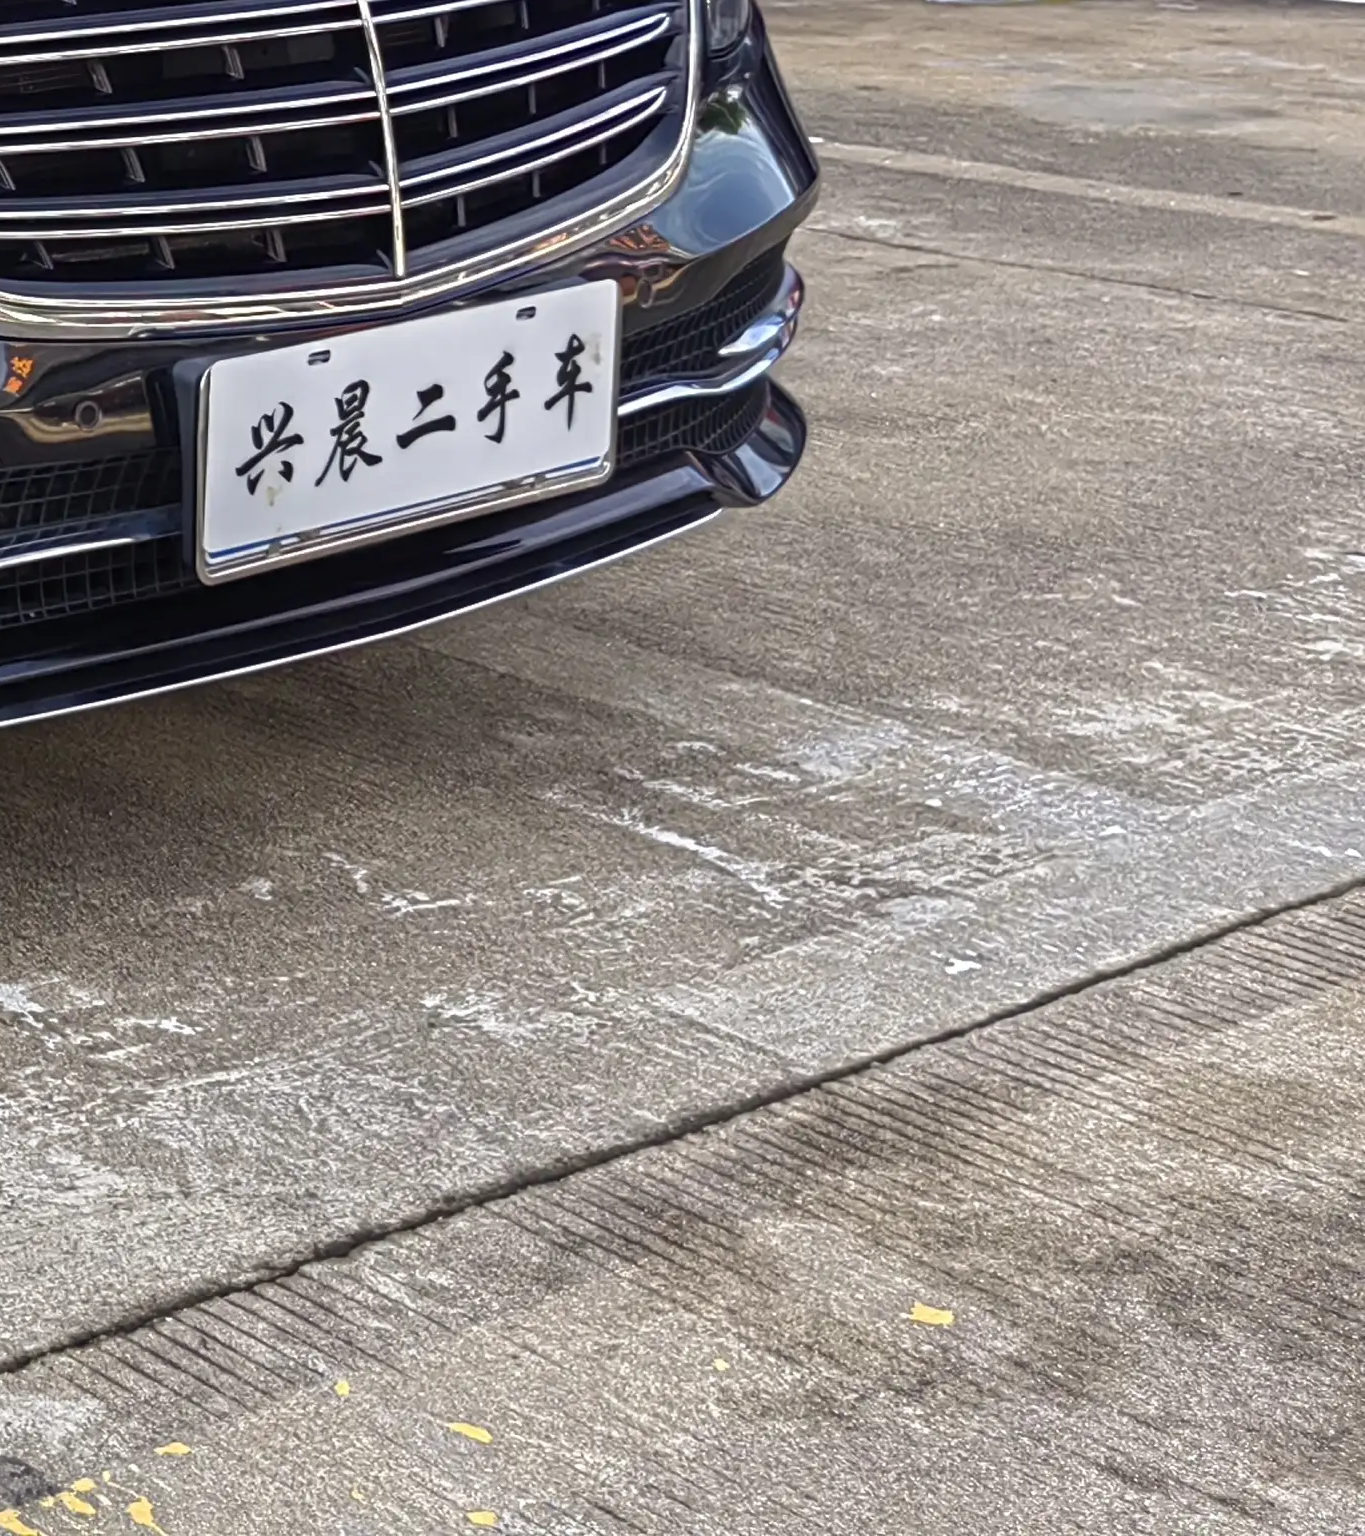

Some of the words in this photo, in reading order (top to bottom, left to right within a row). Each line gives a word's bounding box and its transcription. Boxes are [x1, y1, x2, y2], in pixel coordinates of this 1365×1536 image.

[234, 332, 594, 497] 兴晨二手车
